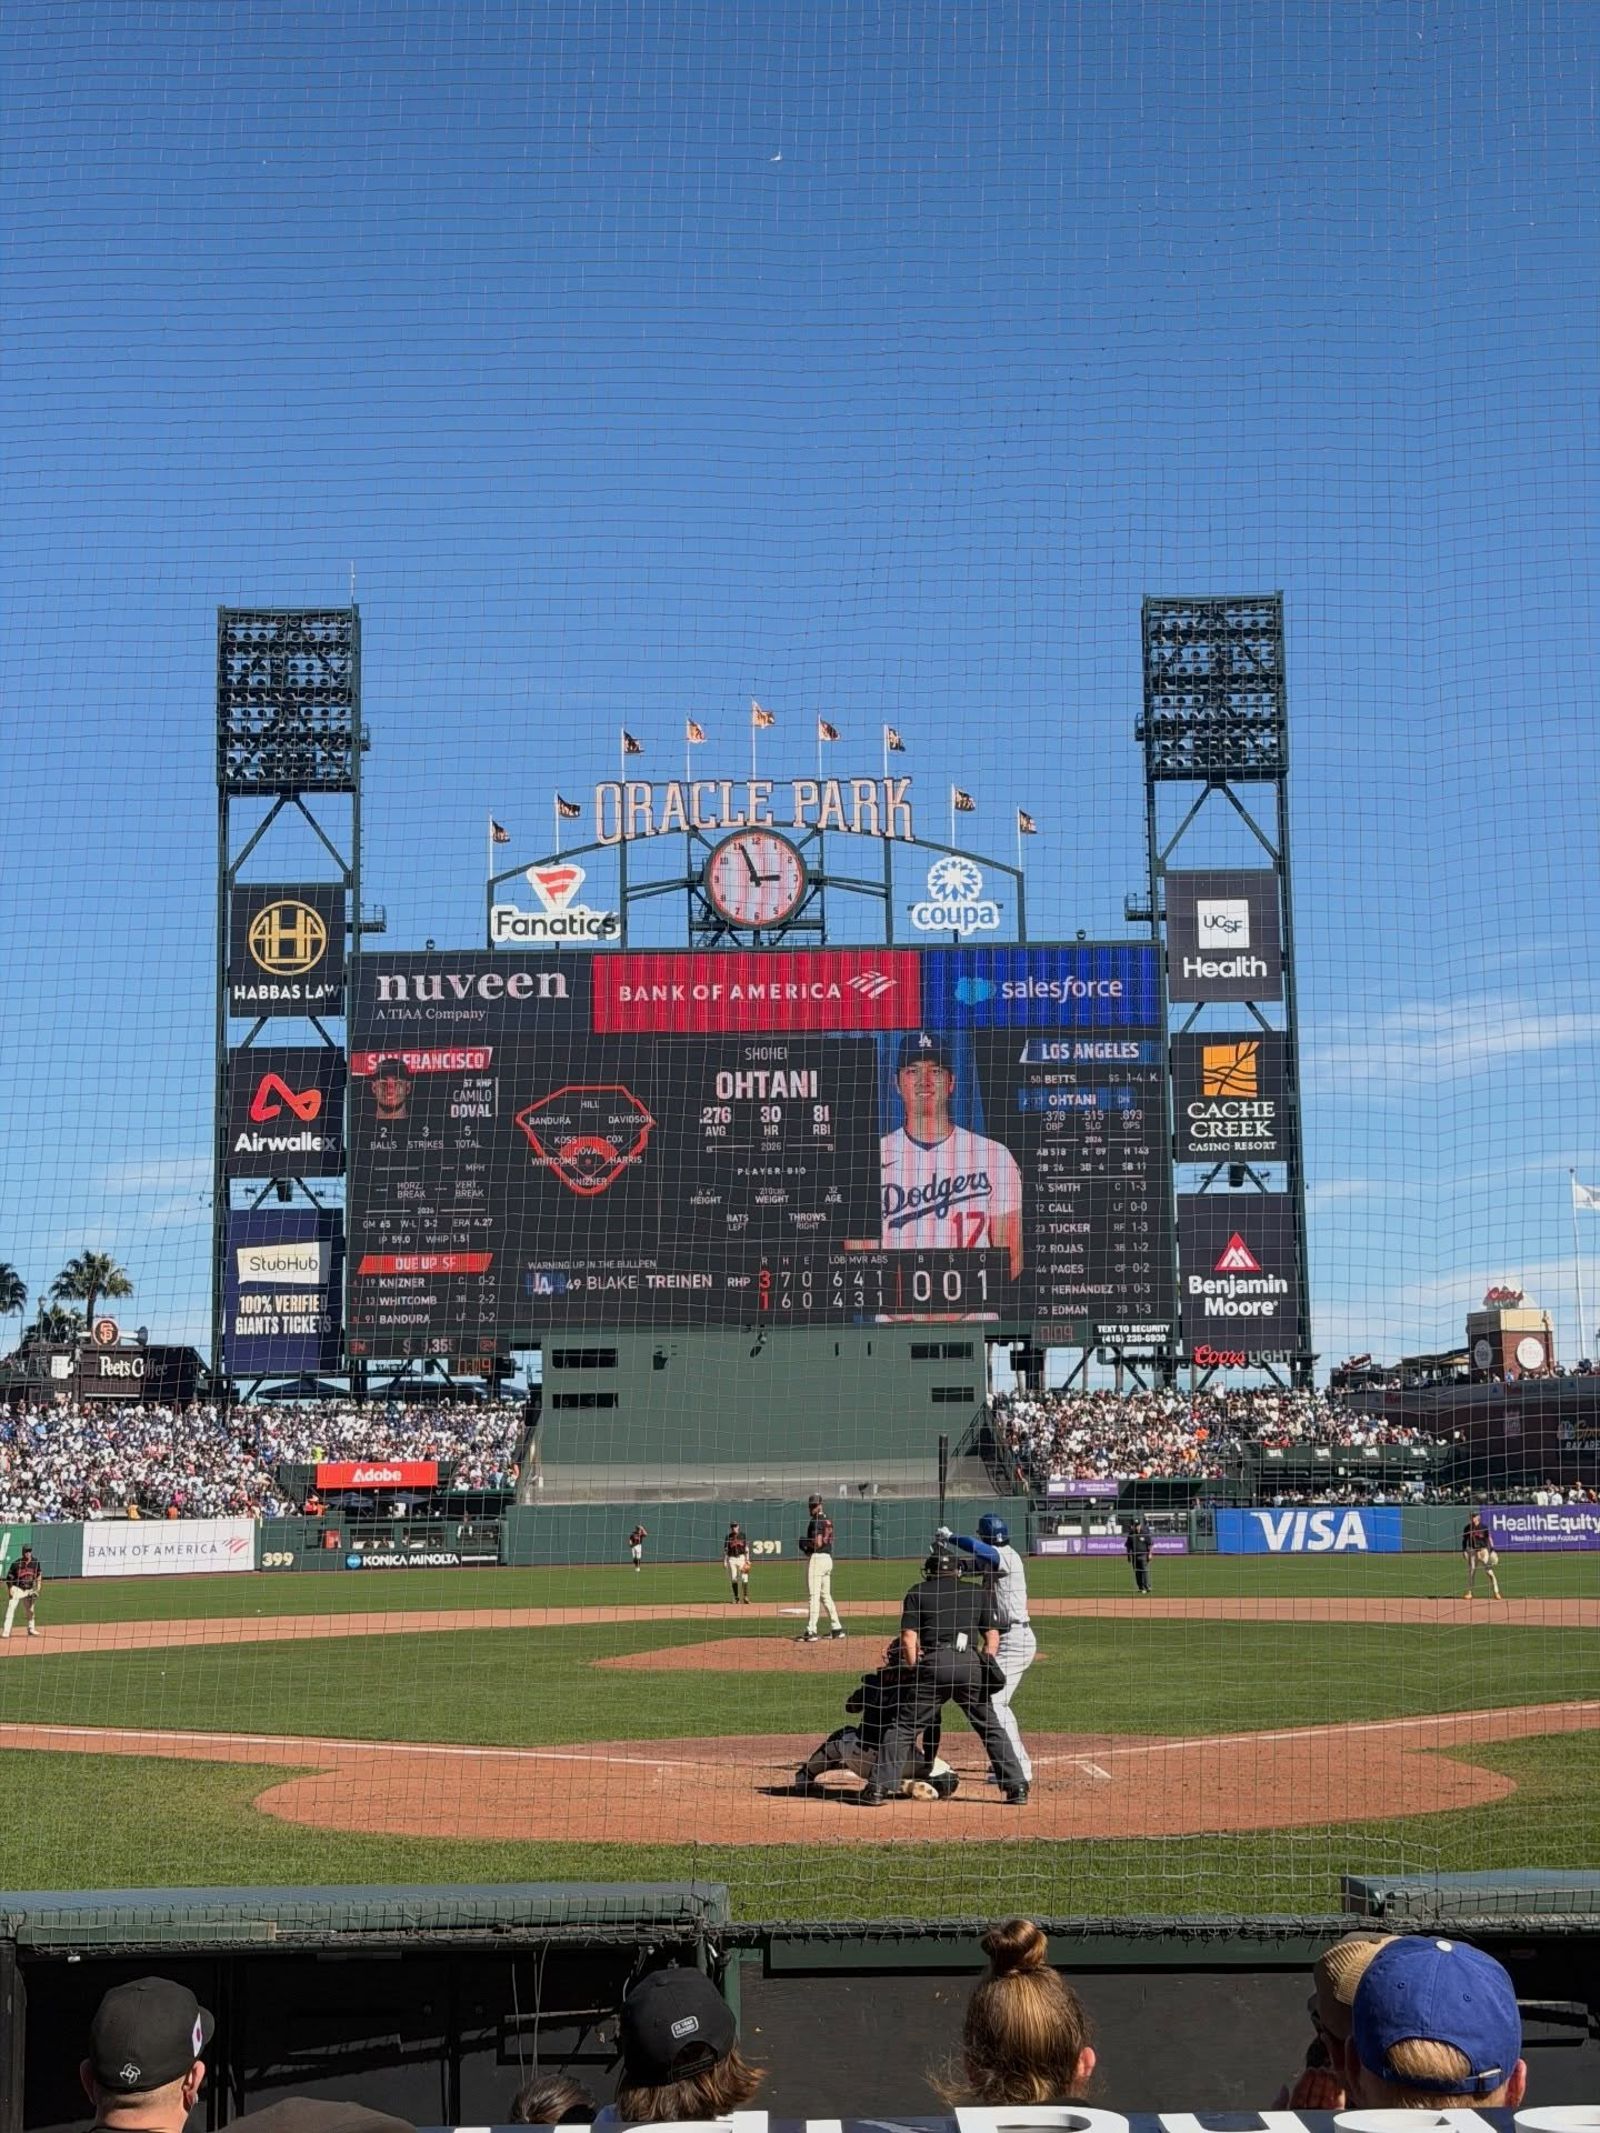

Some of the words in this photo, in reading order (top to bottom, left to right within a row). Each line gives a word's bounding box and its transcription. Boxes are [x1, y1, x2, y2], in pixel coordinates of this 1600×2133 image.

[595, 780, 773, 845] ORACLE
[791, 777, 915, 841] PARK
[917, 904, 994, 929] coupa
[496, 911, 618, 937] Fanatics
[1203, 915, 1243, 933] UCSF
[1183, 956, 1267, 978] Health
[233, 984, 301, 1000] HABBAS
[305, 984, 339, 999] LAW
[376, 971, 569, 1001] nuveen
[619, 985, 684, 1001] BANK
[692, 985, 722, 1000] OF
[729, 982, 841, 1000] AMERICA
[1001, 975, 1123, 1003] salesforce
[376, 1009, 385, 1020] A
[388, 1008, 423, 1020] TIAA
[425, 1007, 486, 1021] Company
[744, 1047, 788, 1060] SHOHEI
[1041, 1043, 1070, 1060] LOS
[1073, 1042, 1139, 1059] ANGELES
[403, 1052, 484, 1069] FRANCISCO
[715, 1070, 818, 1100] OHTANI
[1044, 1074, 1077, 1084] BETTS
[453, 1090, 492, 1102] CAMILO
[1048, 1094, 1096, 1105] OHTANI
[450, 1104, 492, 1118] DOVAL
[700, 1105, 732, 1124] .276
[760, 1105, 782, 1123] 30
[813, 1105, 830, 1122] 81
[1187, 1101, 1276, 1119] CACHE
[529, 1117, 571, 1125] BANDURA
[608, 1115, 652, 1124] DAVIDSON
[380, 1127, 388, 1138] 2
[422, 1126, 429, 1137] 3
[464, 1125, 471, 1136] 5
[705, 1126, 727, 1137] AVG
[764, 1125, 779, 1136] HR
[812, 1124, 830, 1135] RBI
[1190, 1121, 1274, 1138] CREEK
[234, 1131, 336, 1152] Airwallex
[370, 1141, 397, 1150] BALLS
[408, 1140, 443, 1149] STRIKES
[455, 1139, 481, 1149] TOTAL
[554, 1136, 577, 1144] KOSS
[606, 1135, 623, 1143] COX
[761, 1142, 782, 1151] 2026
[1188, 1142, 1231, 1152] CASINO
[1234, 1141, 1277, 1150] RESORT
[531, 1157, 578, 1166] WHITCOMB
[609, 1156, 642, 1164] HARRIS
[737, 1167, 782, 1175] PLAYER
[397, 1190, 426, 1198] BREAK
[455, 1189, 484, 1197] BREAK
[1047, 1183, 1081, 1192] SMITH
[690, 1196, 722, 1204] HEIGHT
[755, 1195, 789, 1204] WEIGHT
[824, 1195, 843, 1203] AGE
[881, 1172, 993, 1220] Dodgers
[1048, 1203, 1074, 1213] CALL
[452, 1219, 470, 1227] ERA
[726, 1214, 749, 1222] BATS
[788, 1213, 827, 1222] THROWS
[728, 1223, 747, 1231] LEFT
[796, 1222, 819, 1230] RIGHT
[952, 1211, 985, 1248] 17
[1048, 1223, 1090, 1233] TUCKER
[1050, 1244, 1084, 1253] ROJAS
[249, 1256, 318, 1271] StubHub
[395, 1258, 418, 1270] DUE
[421, 1257, 438, 1270] UP
[442, 1257, 456, 1269] SF
[572, 1261, 586, 1269] UP
[588, 1260, 596, 1269] IN
[598, 1260, 614, 1268] THE
[617, 1259, 657, 1268] BULLPEN
[829, 1256, 846, 1264] LOB
[850, 1256, 868, 1264] MVR
[870, 1256, 888, 1264] ABS
[1050, 1264, 1084, 1274] PAGES
[379, 1277, 425, 1288] KNIZNER
[566, 1279, 581, 1290] 49
[587, 1275, 638, 1290] BLAKE
[645, 1273, 713, 1289] TREINEN
[727, 1277, 751, 1287] RHP
[759, 1271, 771, 1288] 3
[781, 1272, 790, 1287] 7
[802, 1271, 812, 1287] 0
[833, 1271, 843, 1286] 6
[853, 1270, 863, 1286] 4
[877, 1270, 882, 1285] 1
[913, 1271, 931, 1301] 0
[943, 1270, 961, 1301] 0
[977, 1269, 987, 1300] 1
[1051, 1283, 1113, 1294] HERNÁNDEZ
[1188, 1274, 1288, 1299] Benjamin
[240, 1295, 272, 1314] 100%
[275, 1294, 328, 1313] VERIFIED
[379, 1296, 437, 1305] WHITCOMB
[479, 1294, 495, 1304] 2-2
[760, 1293, 768, 1310] 1
[781, 1292, 791, 1308] 6
[802, 1292, 812, 1308] 0
[833, 1292, 843, 1308] 4
[854, 1291, 864, 1308] 3
[877, 1291, 883, 1307] 1
[1204, 1297, 1274, 1316] Moore
[1051, 1305, 1088, 1315] EDMAN
[235, 1316, 280, 1335] GIANTS
[282, 1315, 332, 1334] TICKETS
[379, 1314, 430, 1324] BANDURA
[1097, 1324, 1117, 1333] TEXT
[1119, 1325, 1130, 1333] TO
[1131, 1324, 1170, 1333] SECURITY
[1194, 1344, 1246, 1365] Coors
[1248, 1349, 1292, 1363] LIGHT
[352, 1468, 402, 1483] Adobe
[1251, 1510, 1369, 1550] VISA
[1492, 1513, 1600, 1534] HealthEquity
[88, 1546, 127, 1557] BANK
[131, 1545, 150, 1556] OF
[153, 1543, 218, 1556] AMERICA
[753, 1539, 782, 1556] 391
[262, 1552, 294, 1567] 399
[362, 1554, 407, 1567] KONICA
[409, 1553, 459, 1565] MINOLTA
